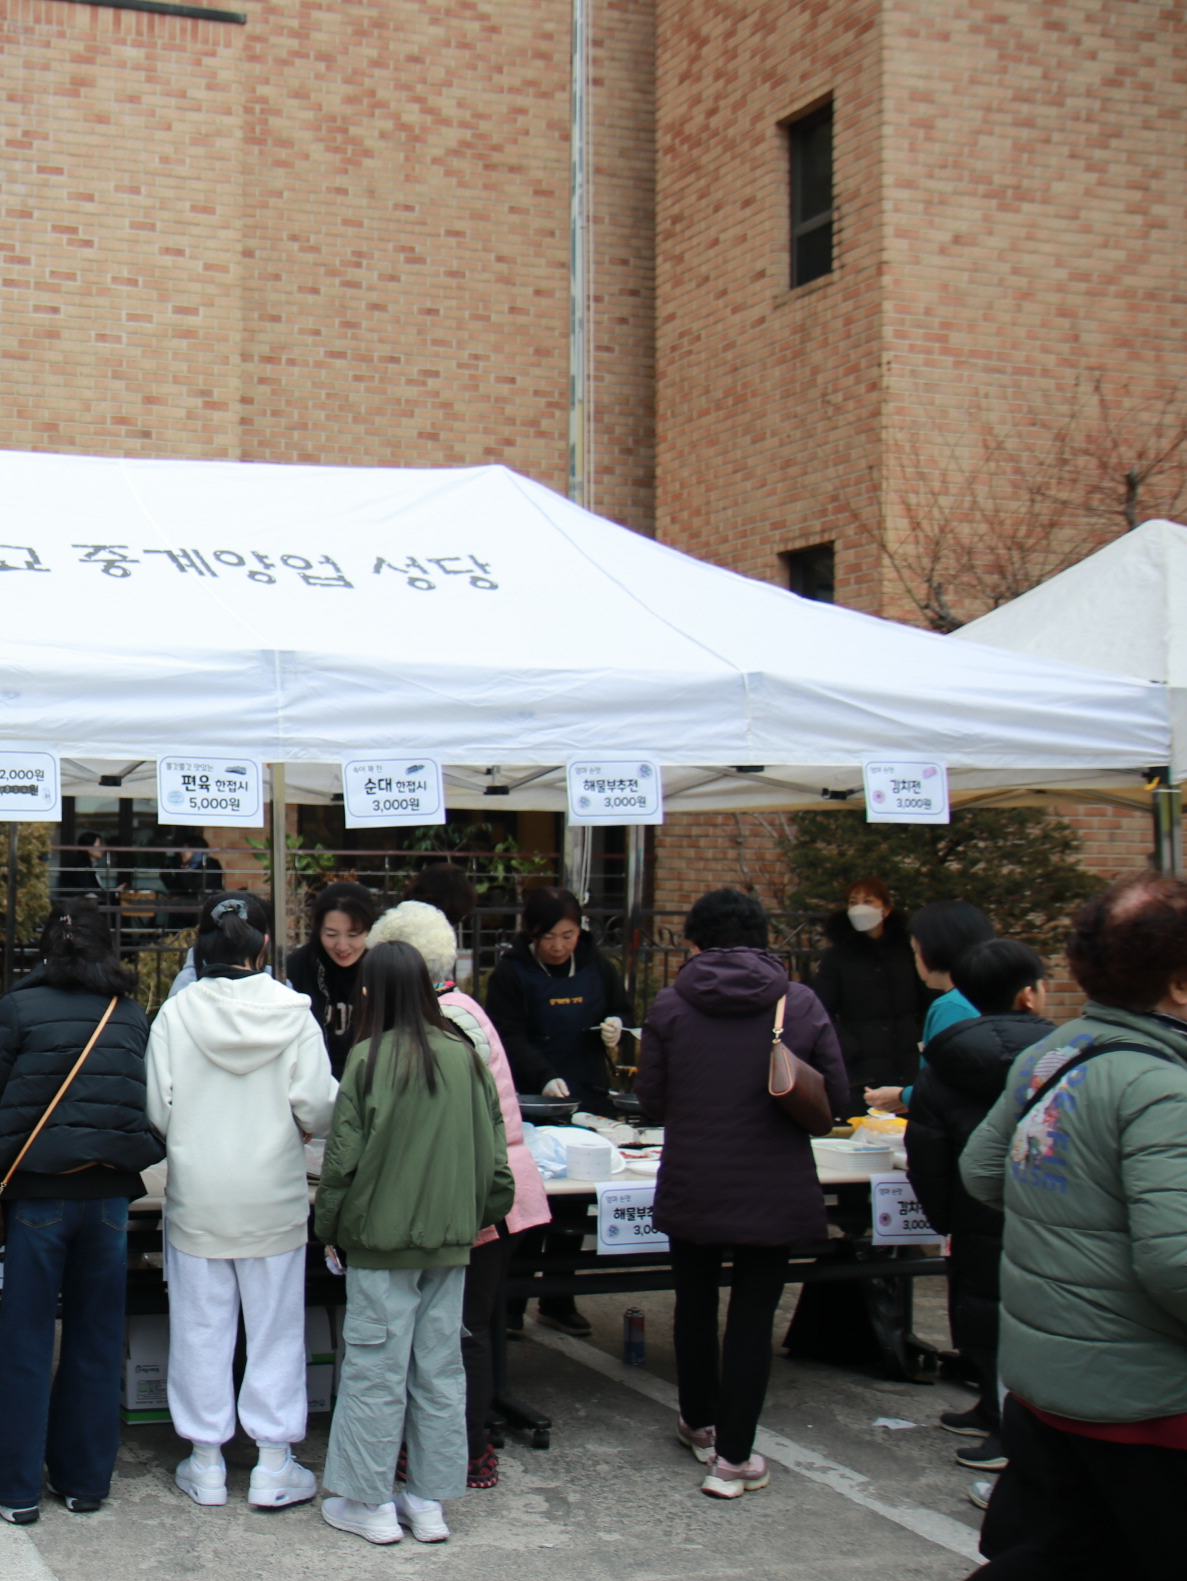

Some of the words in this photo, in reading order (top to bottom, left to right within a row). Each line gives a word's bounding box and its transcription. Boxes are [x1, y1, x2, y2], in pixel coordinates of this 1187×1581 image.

[71, 542, 356, 589] 중계양업
[371, 553, 500, 592] 성당
[0, 769, 44, 781] 2,000원
[181, 775, 211, 793] 편육
[215, 779, 248, 793] 한접시
[364, 778, 392, 795] 순대
[395, 780, 427, 793] 한접시
[583, 779, 639, 793] 해물부추전
[890, 779, 921, 794] 김치전
[189, 797, 240, 811] 5,000원
[372, 798, 420, 812] 3,000원
[604, 796, 646, 809] 3,000원
[896, 798, 932, 810] 3,000원
[897, 1200, 923, 1216] 김치
